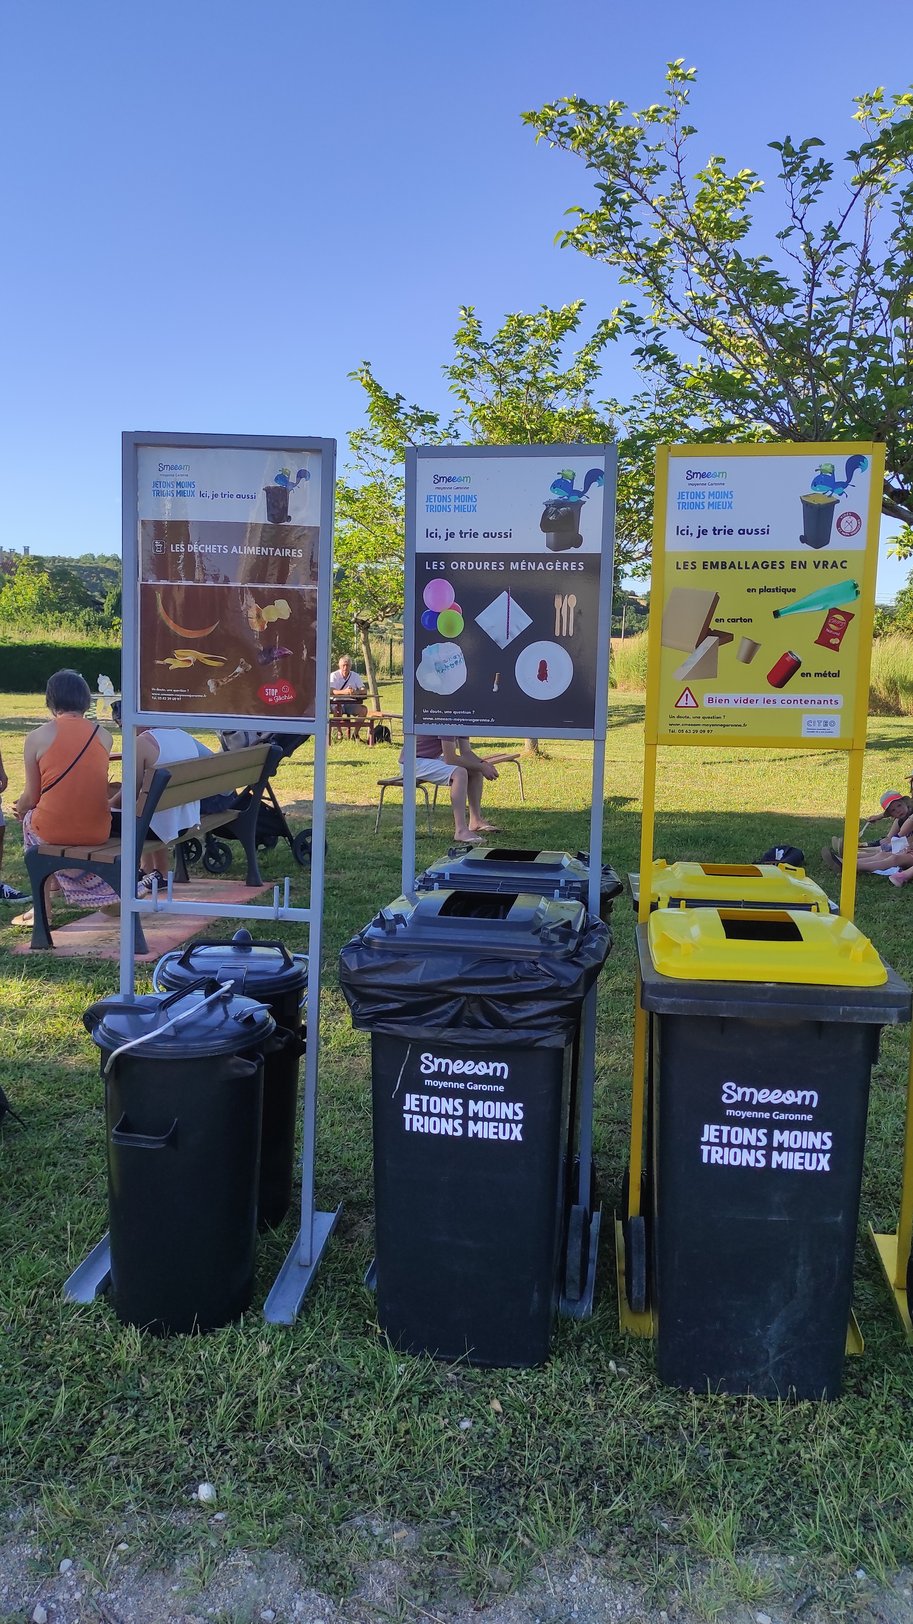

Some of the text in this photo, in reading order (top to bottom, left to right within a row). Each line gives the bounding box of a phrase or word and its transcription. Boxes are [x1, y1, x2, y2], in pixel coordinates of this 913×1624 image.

[158, 462, 190, 472] Smeeom
[433, 474, 471, 485] Smeeom
[686, 469, 727, 480] Smeeom
[152, 481, 195, 489] JETONS MOINS
[152, 490, 195, 498] TRIONS MIEUX
[199, 491, 210, 499] Ici,
[211, 491, 219, 500] je
[236, 492, 256, 500] aussi
[426, 495, 477, 503] JETONS MOINS
[677, 491, 734, 500] JETONS MOINS
[426, 504, 477, 513] TRIONS MIEUX
[677, 501, 733, 510] TRIONS MIEUX
[426, 529, 512, 541] Ici, je trie aussi
[676, 525, 770, 538] Ici, je trie aussi
[170, 541, 303, 558] LES DÉCHETS ALIMENTAIRES
[425, 559, 584, 571] LES ORDURES MÉNAGÈRES
[676, 560, 848, 570] LES EMBALLAGES EN VRAC
[759, 586, 796, 595] plastique
[814, 670, 840, 678] métal
[265, 688, 278, 696] STOP
[707, 696, 839, 706] Bien vider les contenants
[420, 1052, 509, 1080] Smeeom
[424, 1079, 505, 1092] moyenne Garonne
[721, 1081, 819, 1108] Smeeom
[403, 1093, 524, 1120] JETONS MOINS
[726, 1109, 813, 1121] moyenne Garonne
[403, 1113, 523, 1141] TRIONS MIEUX
[700, 1124, 833, 1150] JETONS MOINS
[700, 1145, 831, 1172] TRIONS MIEUX
